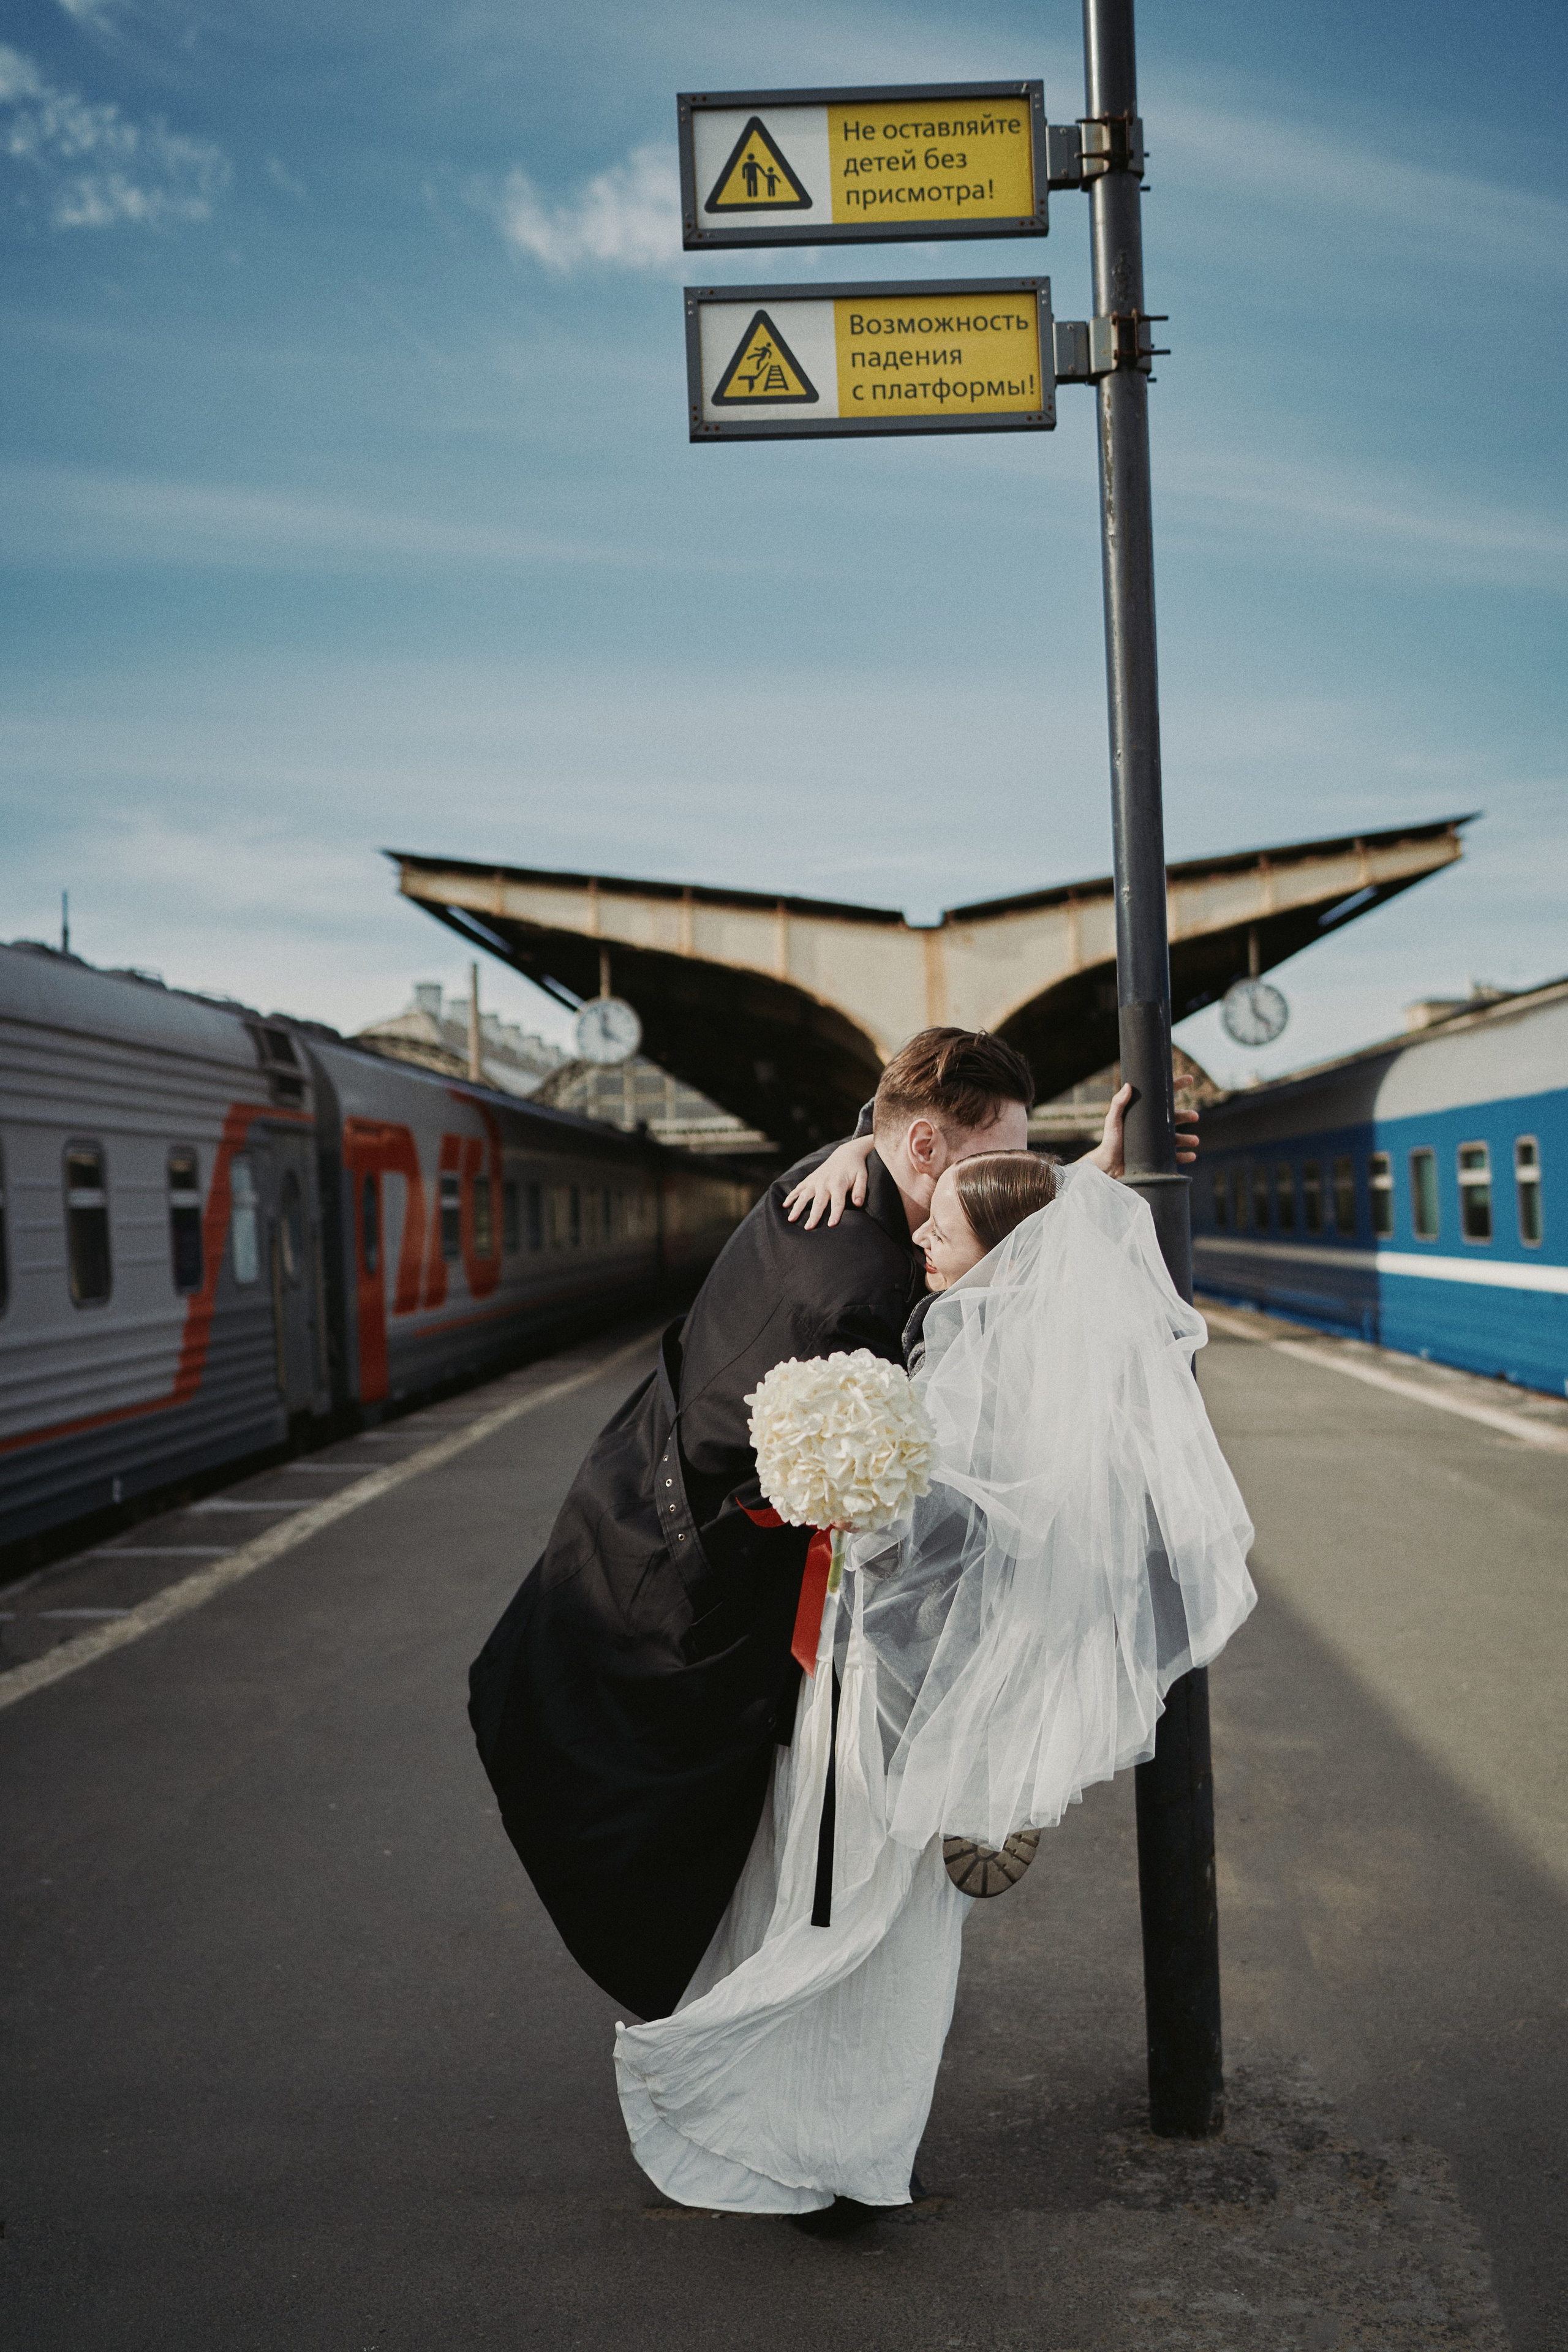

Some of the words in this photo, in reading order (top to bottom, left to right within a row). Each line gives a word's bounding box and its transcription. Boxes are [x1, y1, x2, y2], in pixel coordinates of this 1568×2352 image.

[843, 120, 876, 141] Не
[882, 113, 1022, 140] оставляйте
[843, 149, 916, 177] детей
[924, 147, 968, 170] без
[845, 179, 994, 210] присмотра!
[850, 314, 1030, 336] Возможность
[851, 349, 962, 371] падения
[852, 384, 864, 401] с
[871, 374, 1035, 404] платформы!
